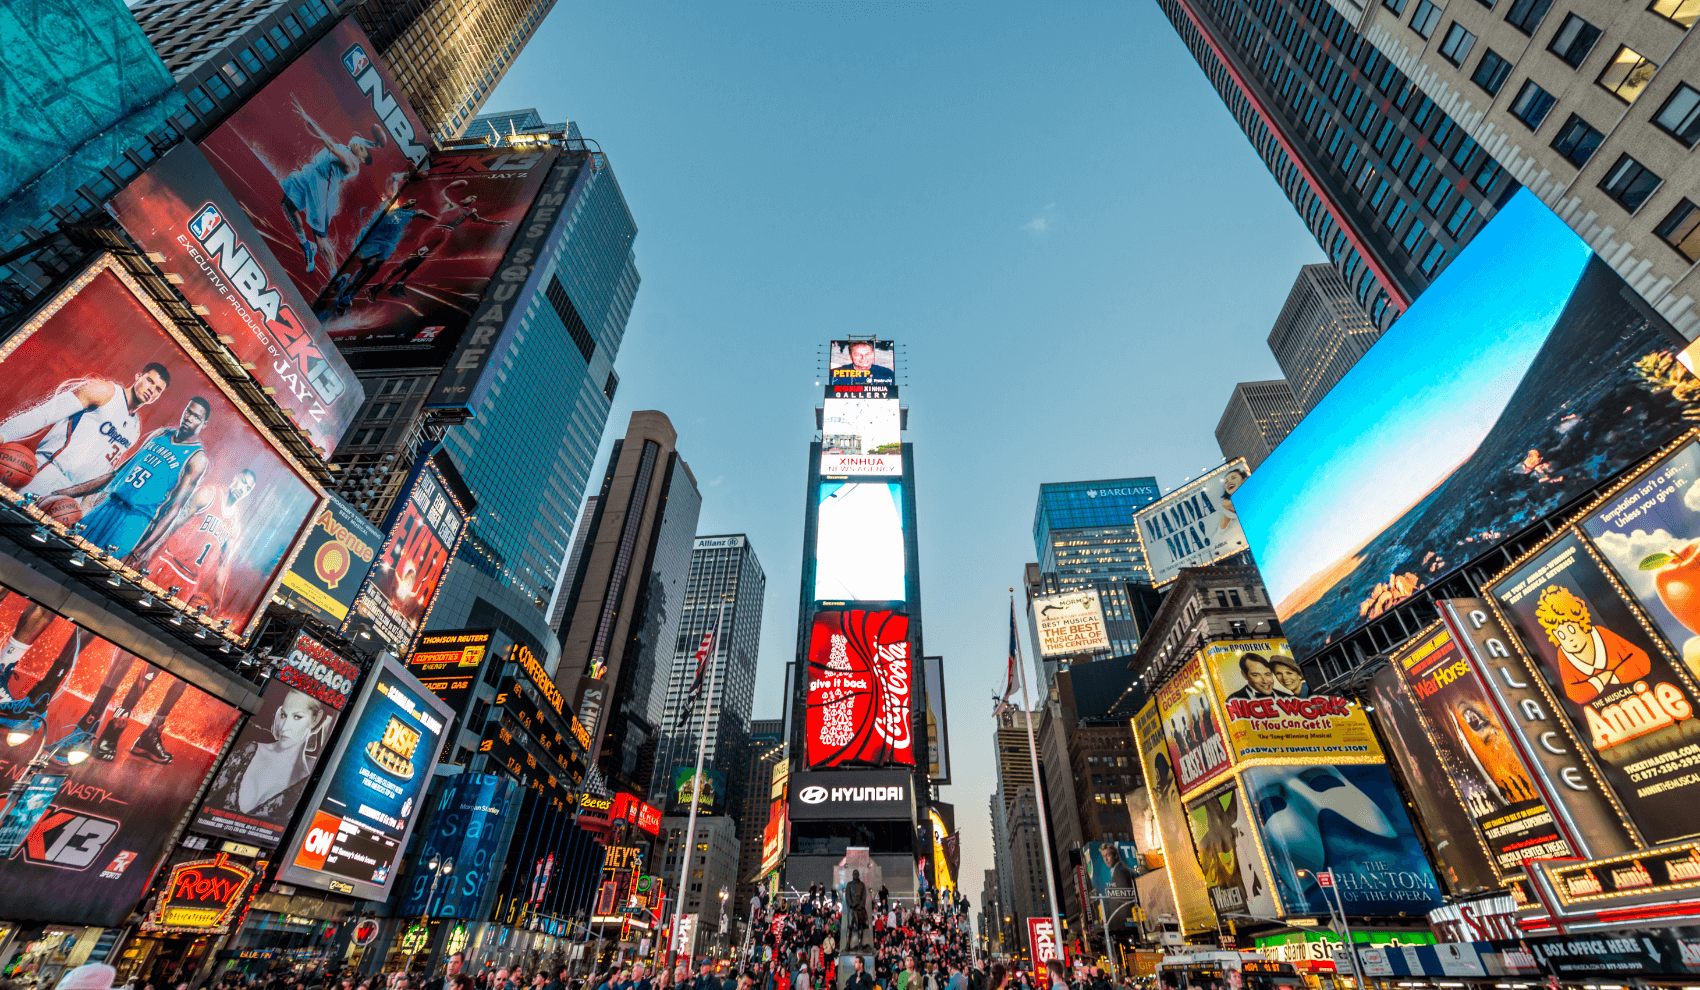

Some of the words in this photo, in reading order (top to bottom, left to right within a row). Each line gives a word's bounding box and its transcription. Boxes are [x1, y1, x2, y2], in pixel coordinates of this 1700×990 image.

[356, 66, 431, 170] NBA
[431, 153, 545, 173] 2K13
[526, 165, 578, 239] TIMES
[176, 233, 229, 295] EXECUTIVE
[226, 294, 270, 347] PRODUCED
[267, 341, 281, 357] BY
[454, 247, 535, 369] SQUARE
[421, 326, 440, 338] 2K
[833, 370, 862, 378] PETER
[863, 370, 873, 378] P.
[273, 359, 314, 403] JAY
[308, 403, 327, 423] Z
[442, 386, 466, 394] NYC
[143, 454, 164, 469] CITY
[839, 458, 885, 466] XINHUA
[124, 465, 154, 489] 35
[1100, 487, 1152, 497] BARCLAYS
[1600, 494, 1641, 524] Temptation
[1638, 479, 1658, 497] isn't
[1656, 476, 1665, 485] a
[1614, 506, 1642, 528] Unless
[1639, 497, 1657, 515] you
[1655, 485, 1676, 503] give
[1672, 478, 1688, 489] in.
[338, 509, 350, 521] BEST
[350, 519, 368, 536] MUSICAL
[1144, 490, 1217, 543] MAMMA
[315, 509, 374, 563] Avenue
[698, 539, 726, 547] Allianz
[1165, 520, 1211, 562] MIA!
[194, 543, 212, 568] 1
[313, 539, 351, 590] Q
[383, 500, 449, 609] EVITA
[1500, 590, 1512, 602] THE
[1511, 580, 1527, 594] TONY
[1526, 546, 1577, 585] AWARD-WINNING
[1509, 593, 1523, 605] BEST
[1522, 576, 1547, 596] MUSICAL
[1545, 556, 1576, 580] RETURNS!
[1059, 597, 1095, 606] MORMN
[1042, 621, 1061, 629] BEST
[1063, 616, 1099, 625] MUSICAL
[1069, 622, 1100, 634] BEST
[422, 636, 457, 645] THOMSON
[456, 634, 489, 642] REUTERS
[1044, 633, 1087, 645] MUSICAL
[1088, 630, 1102, 638] OF
[1046, 642, 1064, 650] THIS
[1229, 642, 1272, 652] BRODERICK
[296, 634, 358, 681] CHICAGO
[416, 653, 460, 662] COMMODITIES
[421, 663, 447, 671] ENERGY
[288, 649, 352, 695] CHICAGO
[518, 645, 555, 702] CONFERENCE
[552, 688, 565, 716] CALL
[1172, 658, 1200, 688] CROWD
[279, 663, 346, 710] CHICAGO
[422, 682, 449, 691] EADED
[450, 681, 469, 690] GAS
[810, 678, 832, 691] give
[833, 677, 842, 689] it
[843, 678, 867, 689] back
[1161, 689, 1182, 712] GOES
[1225, 697, 1280, 723] NICE
[1276, 695, 1351, 720] WORK
[1468, 609, 1589, 791] PALACE
[1592, 698, 1605, 710] THE
[1604, 686, 1634, 704] MUSICAL
[1250, 720, 1262, 731] If
[1261, 720, 1281, 731] You
[1281, 719, 1301, 729] Can
[1301, 719, 1321, 730] Get
[1321, 719, 1333, 729] It
[1583, 680, 1693, 751] Annie
[382, 718, 420, 760] DISH
[369, 740, 414, 776] NATION
[1178, 743, 1208, 787] JERSEY
[1202, 731, 1227, 775] BOYS
[1630, 772, 1643, 783] OR
[831, 786, 904, 801] HYUNDAI
[460, 803, 481, 811] Morgan
[481, 805, 500, 816] Stanley
[113, 851, 131, 873] 2K
[604, 845, 641, 868] HEY'S
[1496, 849, 1523, 865] LINCOLN
[1520, 844, 1546, 860] CENTER
[1543, 839, 1570, 853] THEAT
[99, 871, 121, 880] SPORTS
[1362, 861, 1389, 871] THE
[1611, 865, 1654, 890] Annie
[1334, 871, 1436, 890] PHANTOM
[1566, 873, 1603, 897] Annie
[1343, 891, 1359, 901] OF
[1361, 890, 1389, 901] THE
[1389, 890, 1432, 901] OPERA
[1511, 884, 1528, 904] nie
[168, 911, 216, 922] DELICATESSEN
[357, 925, 370, 940] W
[1036, 921, 1057, 963] tkts
[239, 950, 258, 959] BLUE
[1283, 940, 1306, 961] sbarro
[1311, 937, 1344, 959] sba
[1502, 945, 1538, 968] Annie
[1542, 942, 1565, 957] BOX
[1567, 940, 1608, 955] OFFICE
[1606, 938, 1641, 953] HERE
